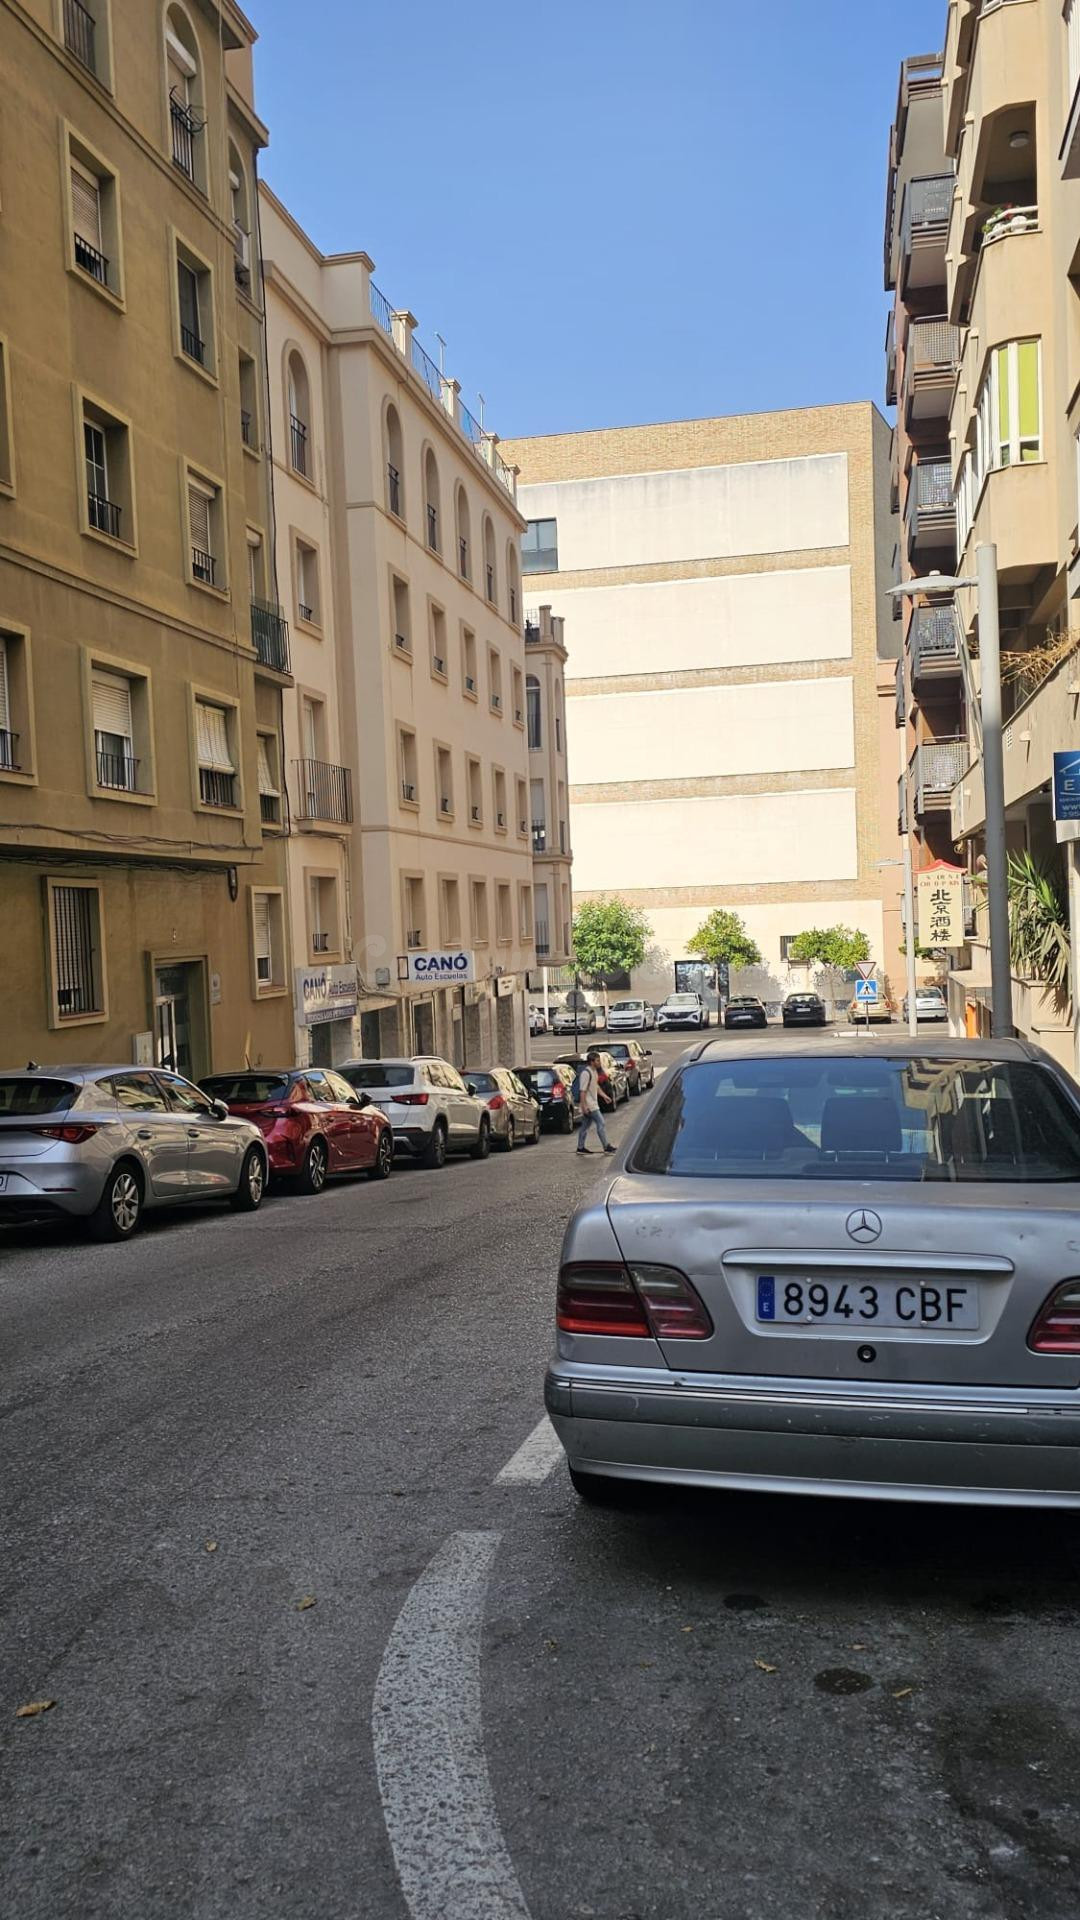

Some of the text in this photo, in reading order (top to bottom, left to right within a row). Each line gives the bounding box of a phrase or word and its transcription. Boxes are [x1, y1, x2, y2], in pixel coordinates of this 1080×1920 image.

[929, 888, 952, 942] 北京酒楼
[414, 952, 468, 971] CANÓ
[303, 972, 327, 1000] CANÓ
[434, 972, 468, 980] Escuelas
[762, 1301, 770, 1313] E
[783, 1282, 967, 1322] 8943 CBF
